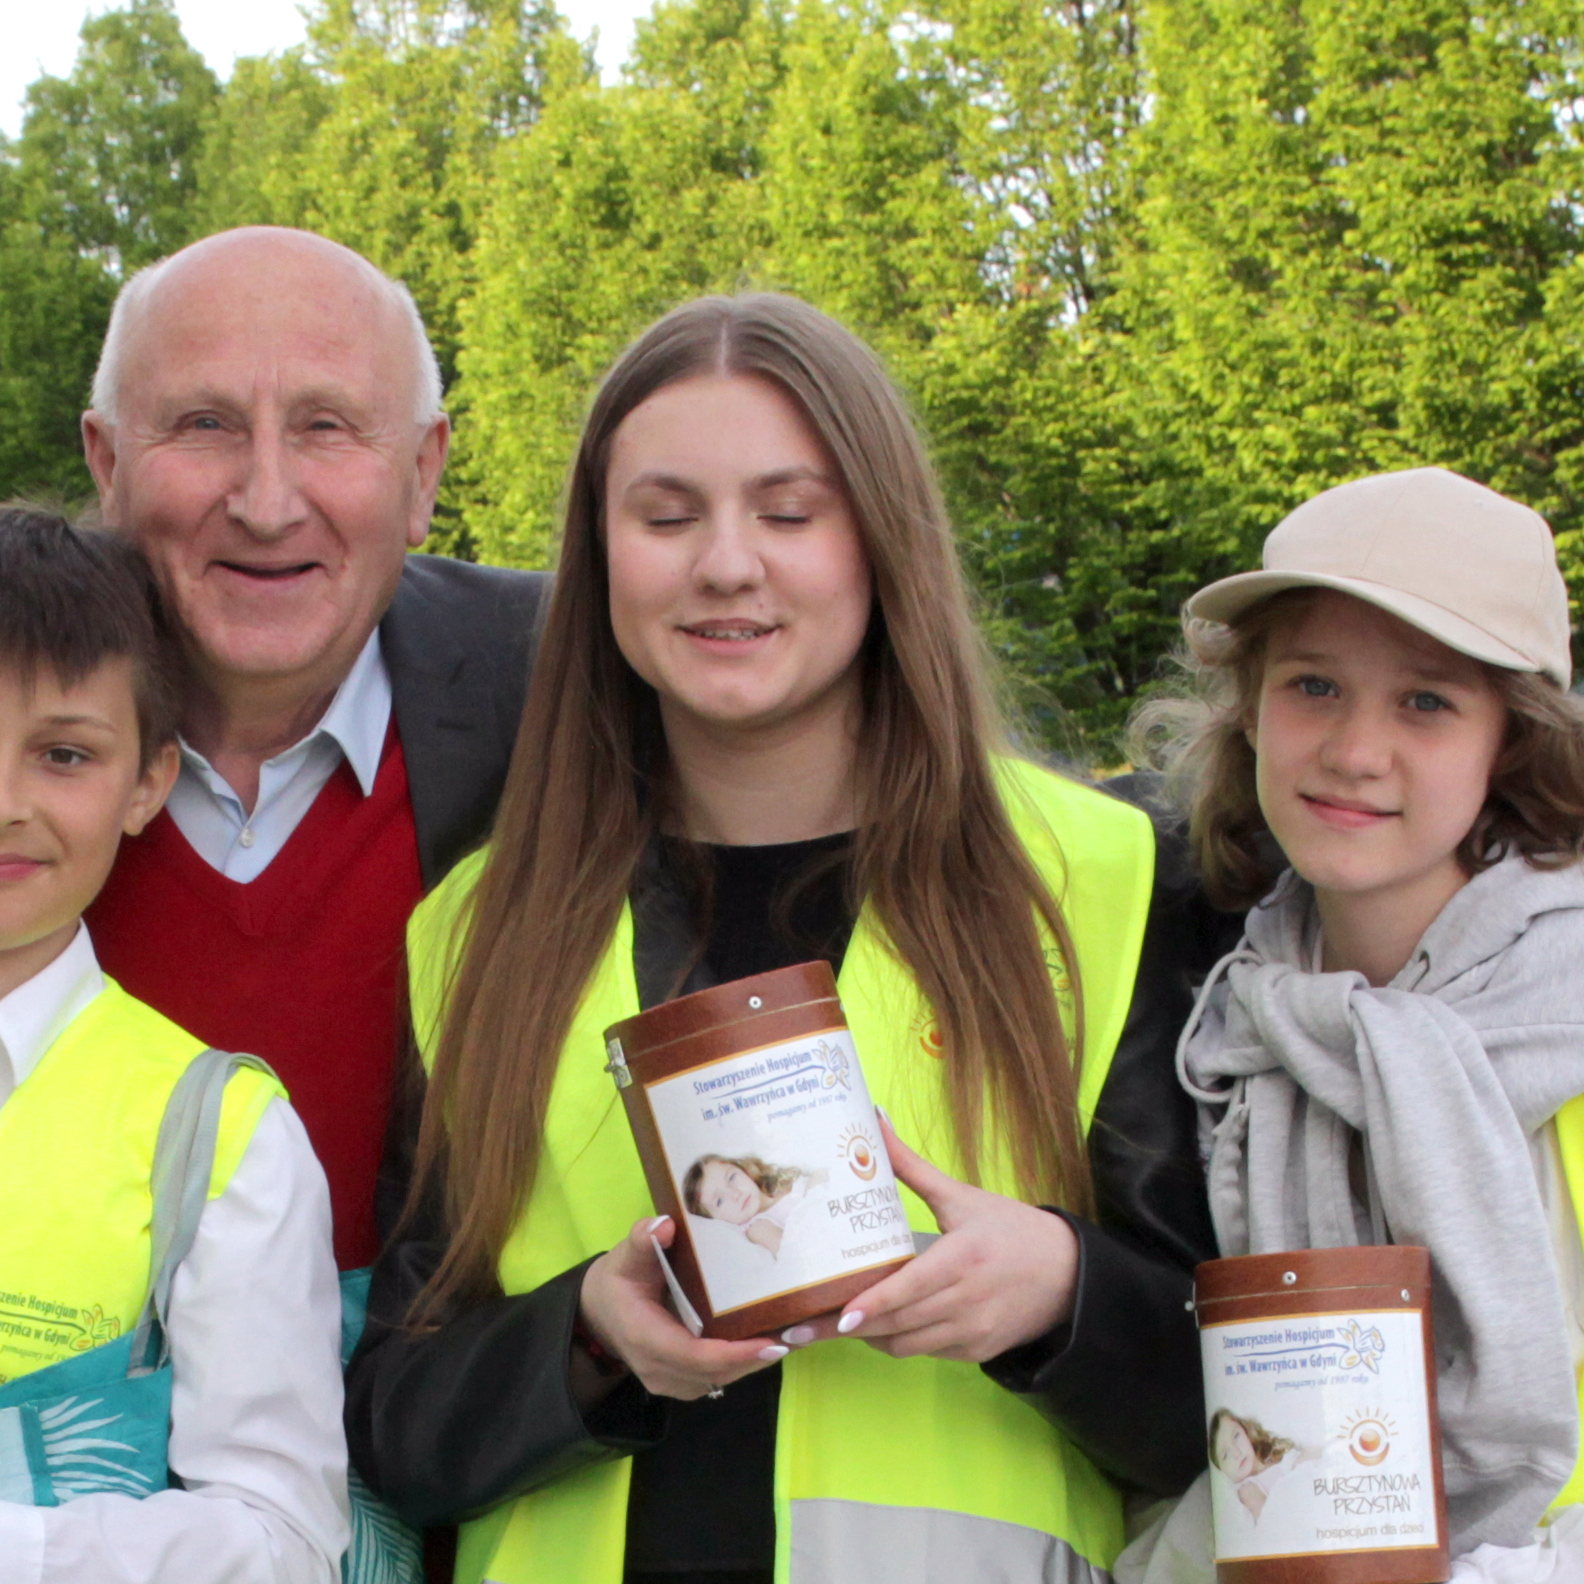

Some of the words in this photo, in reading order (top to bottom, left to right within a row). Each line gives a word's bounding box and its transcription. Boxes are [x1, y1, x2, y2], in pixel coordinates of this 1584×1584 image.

[693, 1056, 768, 1096] Stowarzyszenie
[767, 1049, 813, 1076] Hospicjum
[733, 1086, 787, 1115] Wawrzyńca
[787, 1084, 796, 1098] w
[795, 1075, 820, 1098] Gdyni
[28, 1294, 79, 1319] Hospicjum
[34, 1329, 43, 1340] w
[44, 1328, 72, 1347] Gdyni
[1222, 1332, 1284, 1349] Stowarzyszenie
[1285, 1326, 1335, 1344] Hospicjum
[1248, 1356, 1298, 1374] Wawrzyńca
[1300, 1359, 1309, 1369] w
[1309, 1353, 1337, 1371] Gdyni
[1313, 1472, 1421, 1496] BURSZTYNOWA
[1333, 1492, 1411, 1515] PRZYSTAŃ
[1316, 1524, 1378, 1539] hospicjum
[1381, 1523, 1397, 1536] dla
